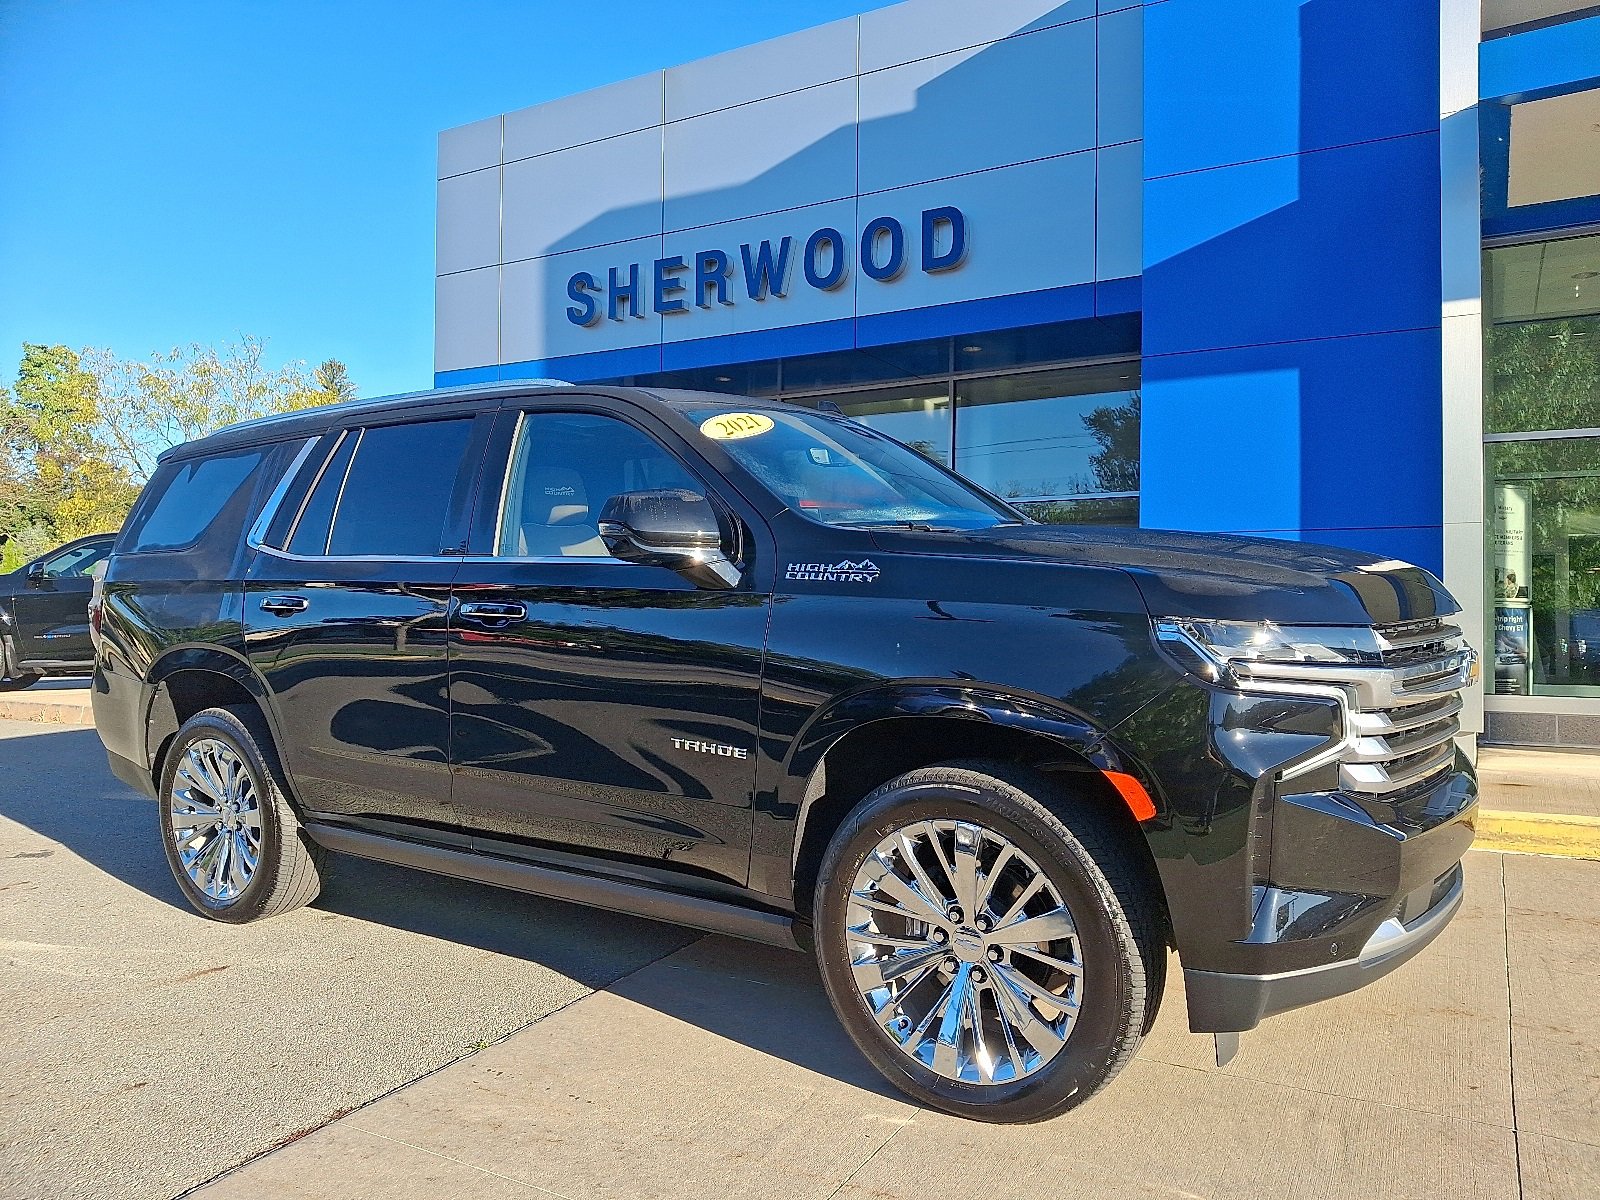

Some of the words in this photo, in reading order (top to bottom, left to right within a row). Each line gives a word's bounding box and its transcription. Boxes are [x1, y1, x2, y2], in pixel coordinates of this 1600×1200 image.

[566, 205, 967, 327] SHERWOOD
[716, 415, 762, 436] 2021
[787, 563, 834, 572] HIGH
[785, 571, 880, 582] COUNTRY
[1508, 615, 1523, 624] right
[670, 737, 748, 760] TAHOE
